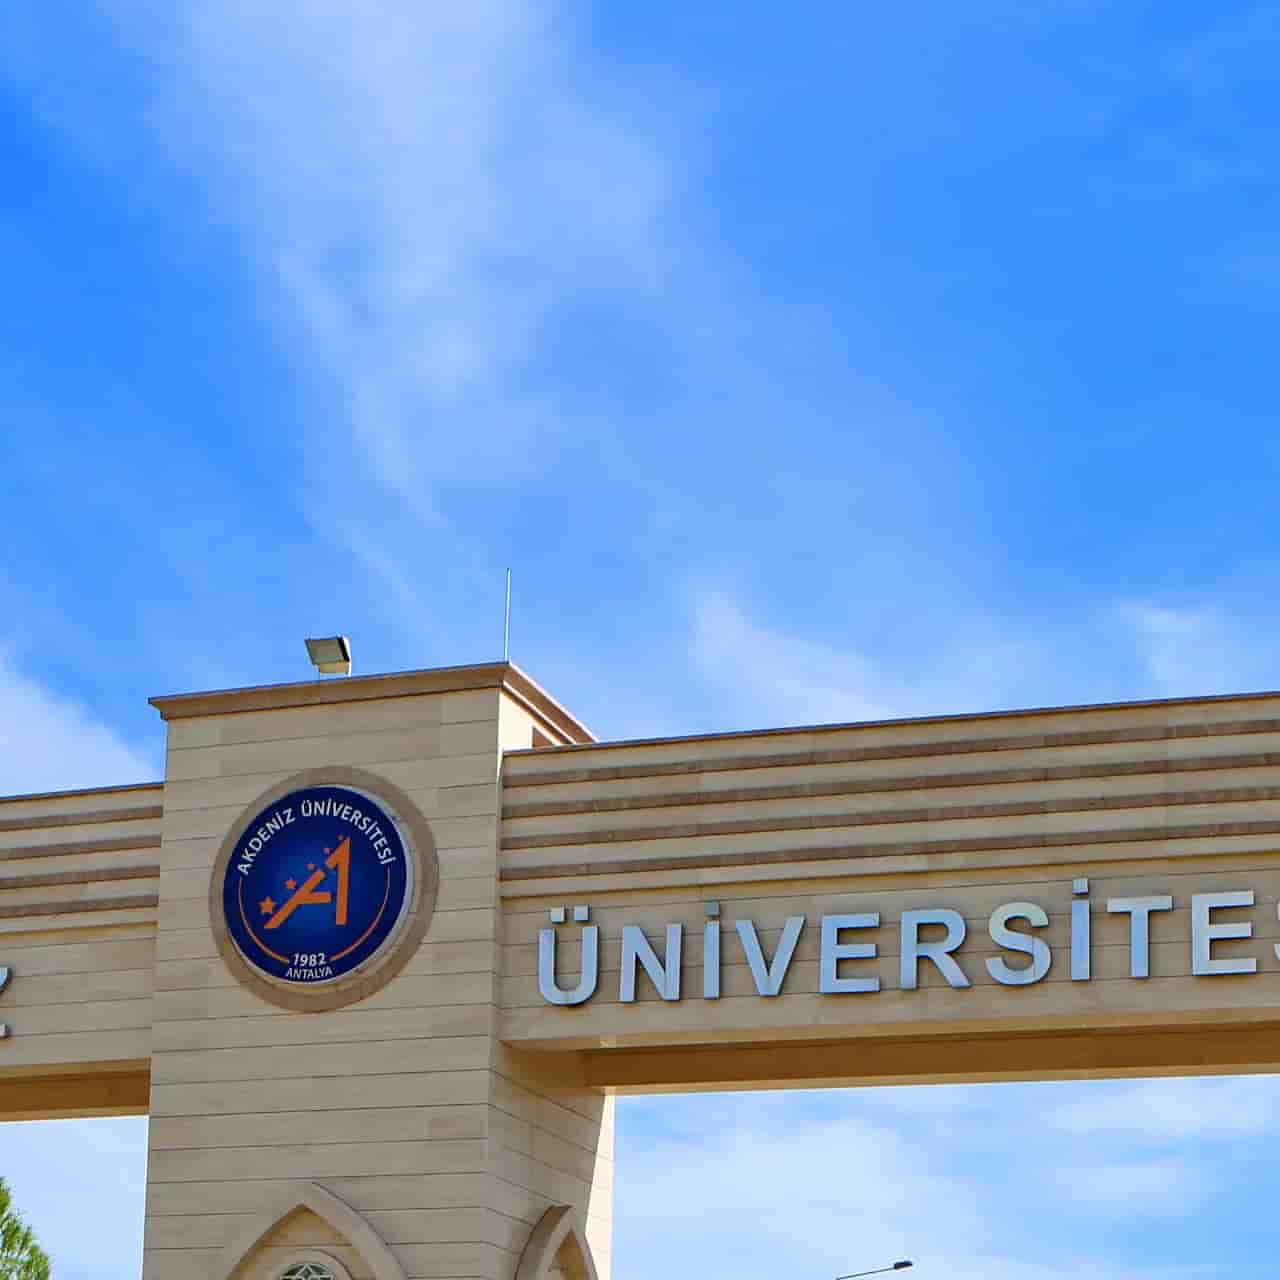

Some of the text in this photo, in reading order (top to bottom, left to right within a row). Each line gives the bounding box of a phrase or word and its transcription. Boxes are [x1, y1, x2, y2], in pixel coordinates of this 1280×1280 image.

[237, 798, 397, 876] AKDENİZ ÜNİVERSİTESİ
[293, 952, 327, 967] 1982
[285, 966, 334, 980] ANTALYA
